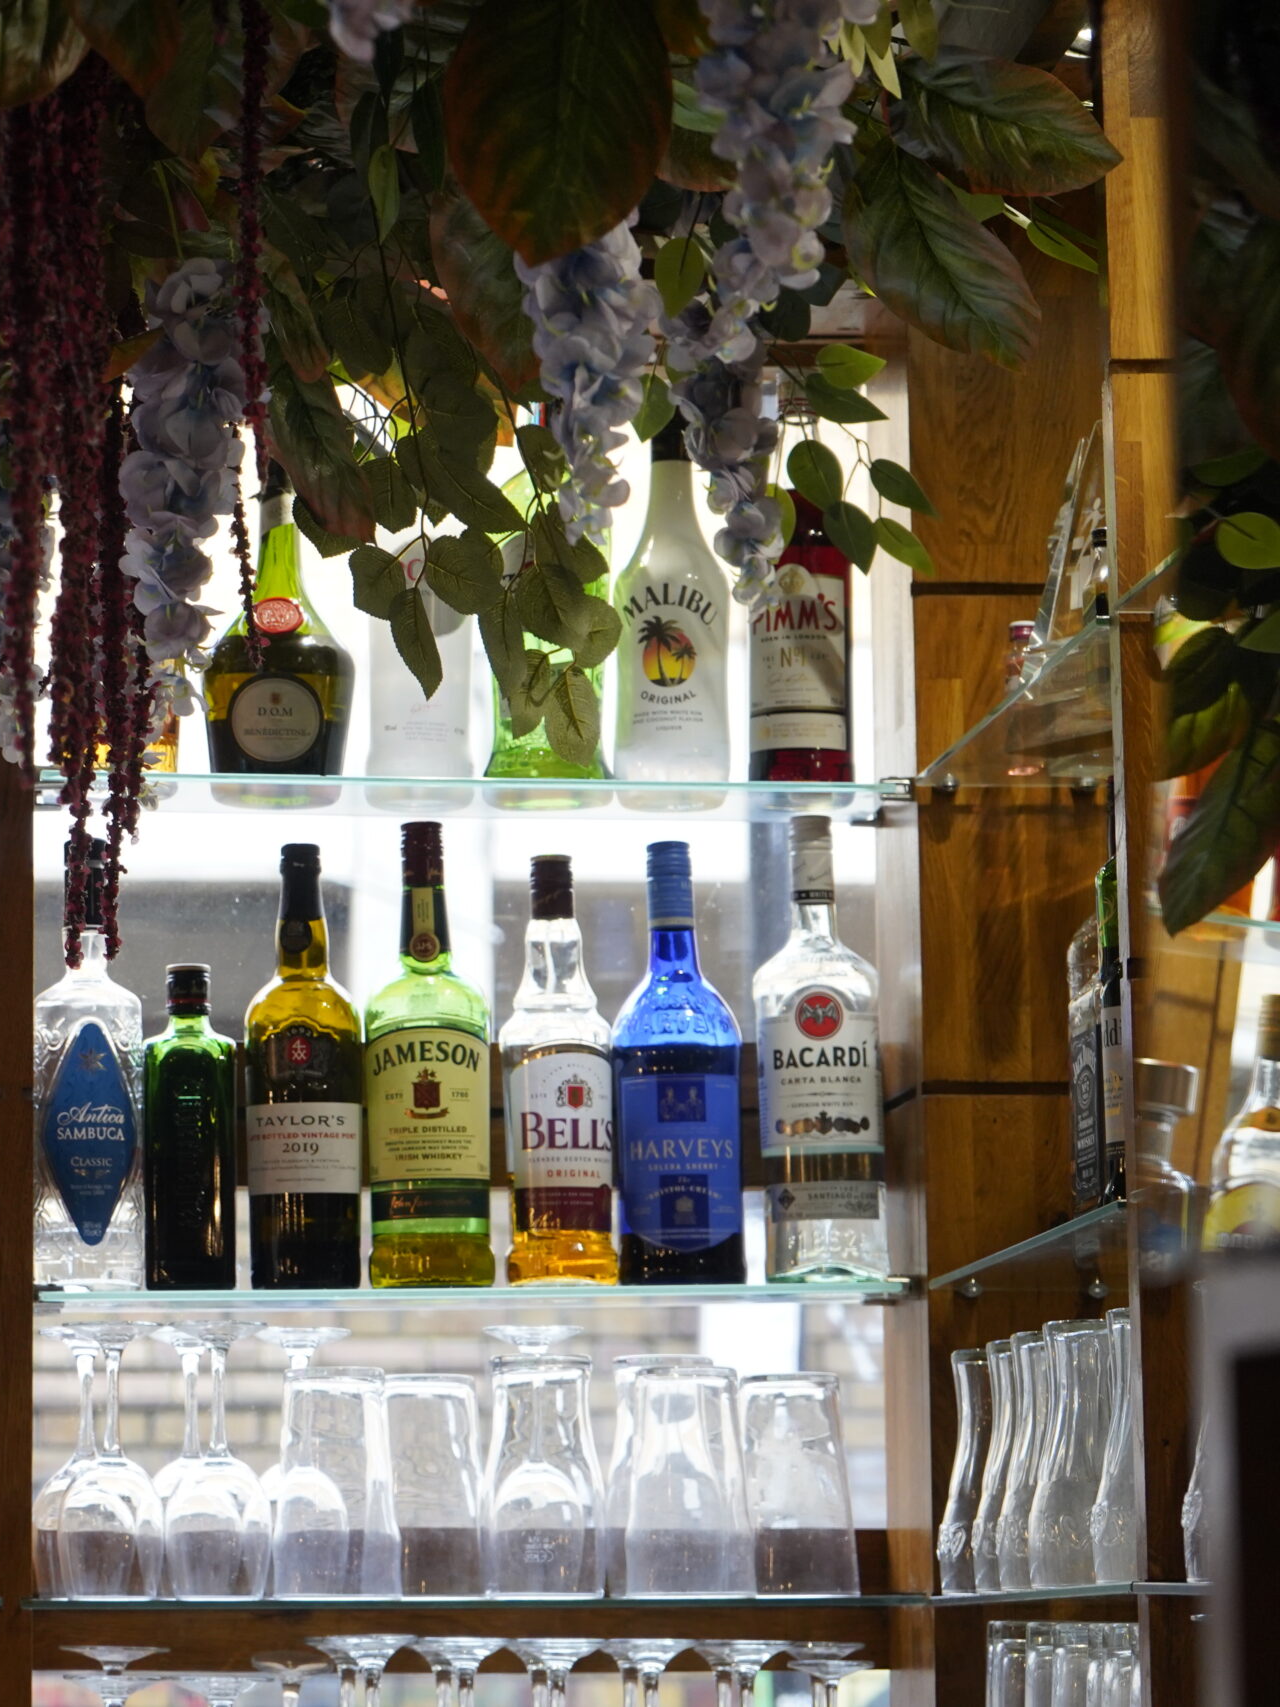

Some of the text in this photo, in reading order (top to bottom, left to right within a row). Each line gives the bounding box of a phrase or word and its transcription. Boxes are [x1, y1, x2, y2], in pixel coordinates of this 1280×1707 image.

[623, 583, 717, 626] MALIBU
[753, 593, 837, 635] PIMM'S
[640, 690, 696, 705] ORIGINAL
[373, 1041, 480, 1076] JAMESON
[773, 1041, 867, 1070] BACARDÍ
[781, 1076, 862, 1086] CARTA BLANCA
[57, 1102, 126, 1126] Antica
[256, 1115, 345, 1127] TAYLOR'S
[57, 1127, 125, 1141] SAMBUCA
[262, 1132, 299, 1141] BOTTLED
[389, 1126, 418, 1134] TRIPLE
[520, 1112, 612, 1152] BELL'S
[282, 1142, 319, 1155] 2019
[630, 1138, 734, 1161] HARVEYS
[70, 1156, 113, 1167] CLASSIC
[395, 1154, 419, 1162] IRISH
[547, 1169, 602, 1179] ORIGINAL
